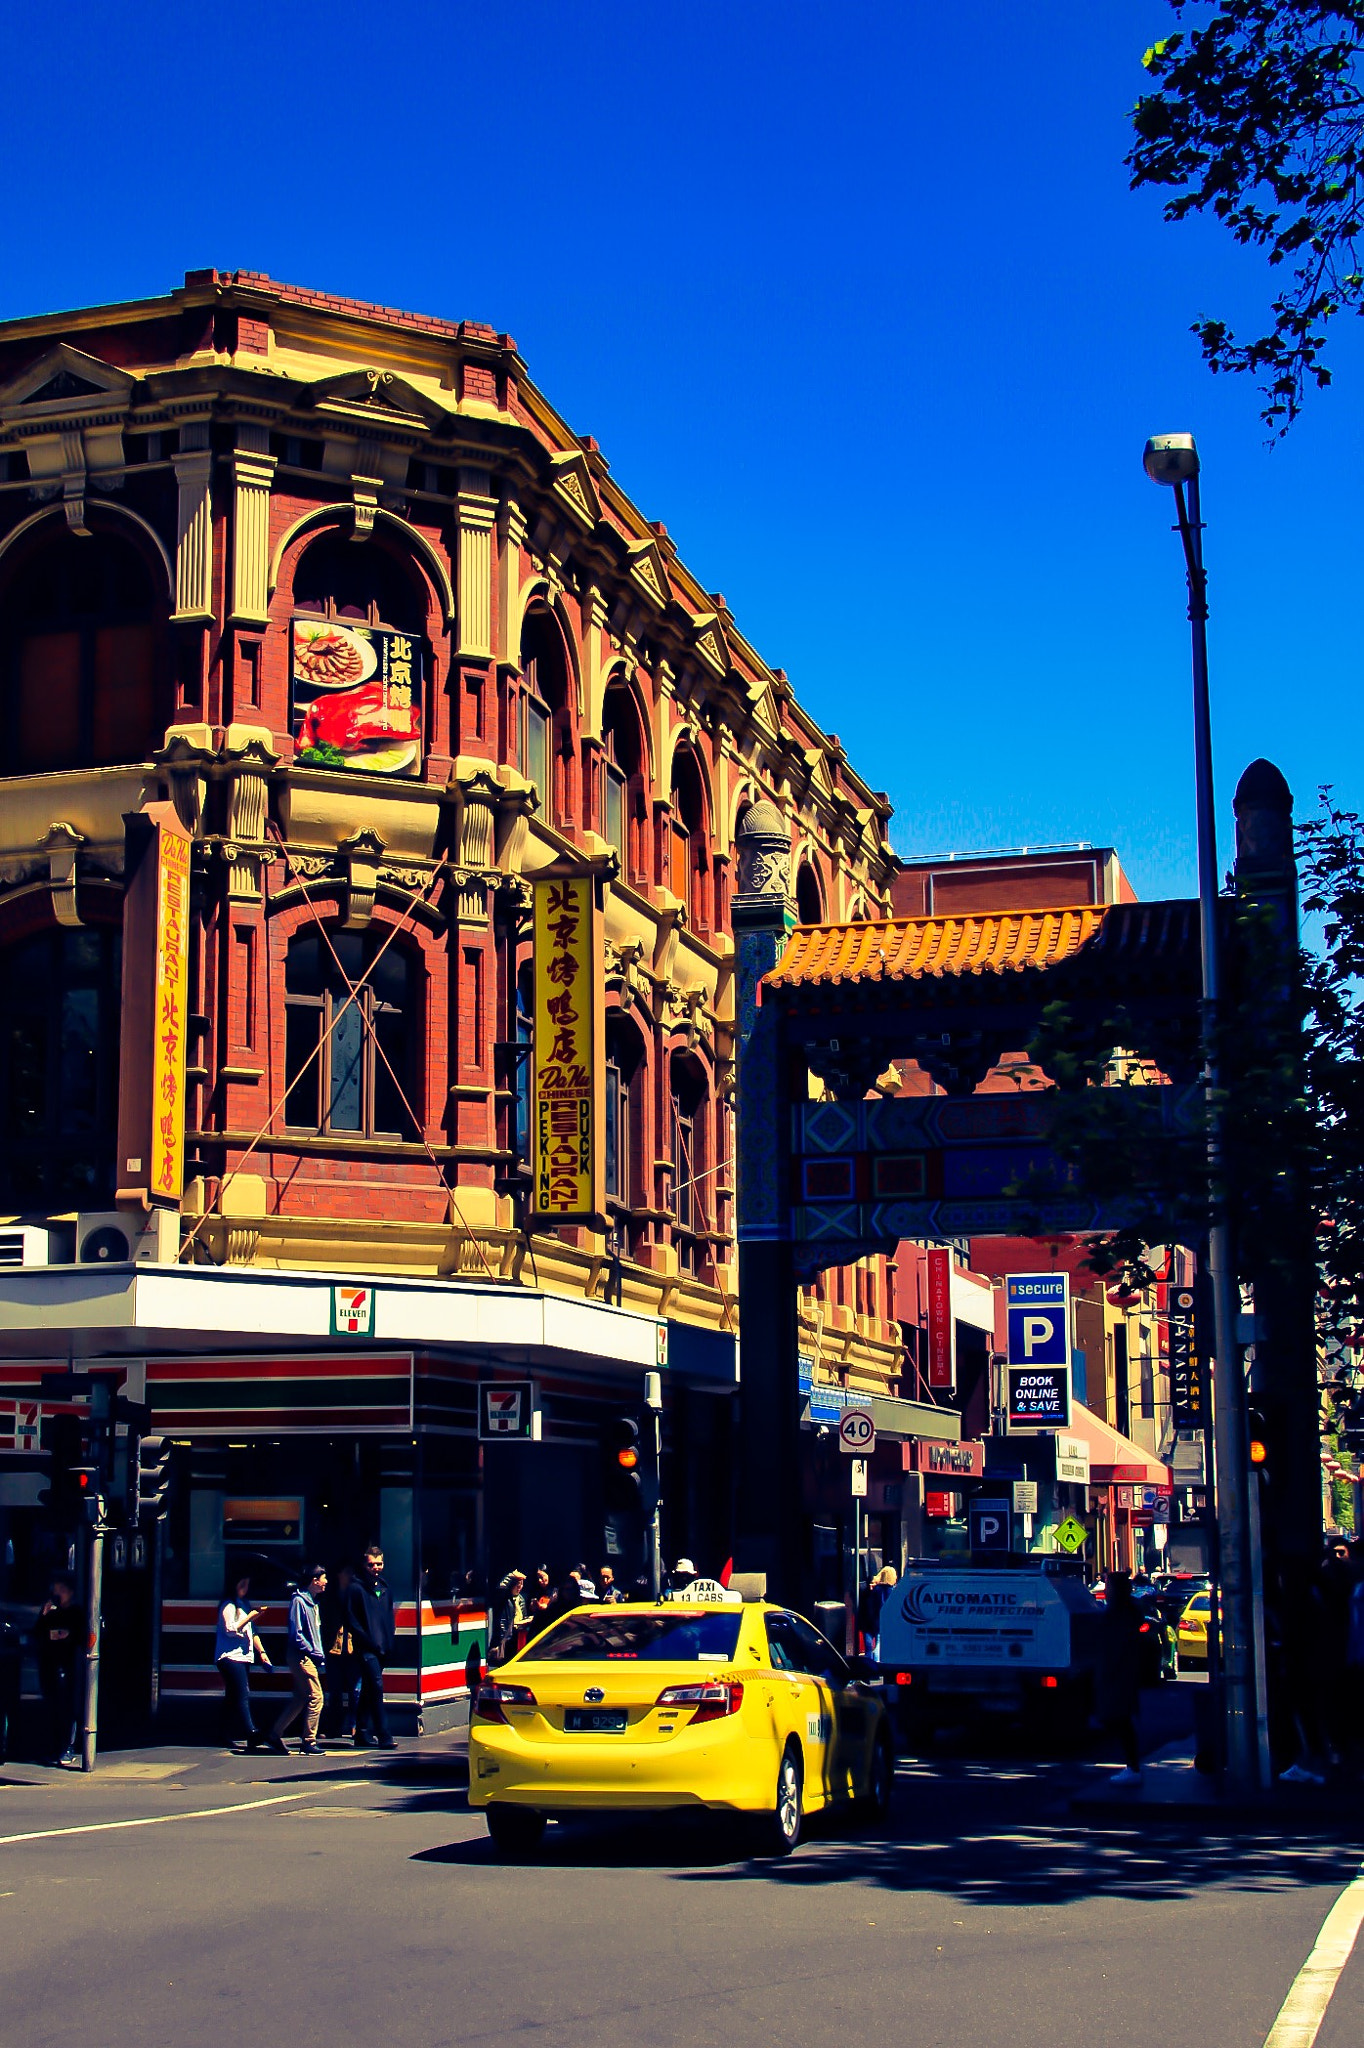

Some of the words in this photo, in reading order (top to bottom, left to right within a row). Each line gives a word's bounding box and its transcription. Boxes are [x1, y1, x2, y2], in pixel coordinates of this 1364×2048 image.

[165, 870, 181, 989] RESTAURANT
[538, 1088, 591, 1100] CHINESE
[579, 1099, 590, 1175] DUCK
[539, 1101, 550, 1210] PEKING
[550, 1100, 578, 1211] RESTAURANT
[934, 1257, 944, 1323] CHINATOWN
[1018, 1283, 1063, 1295] secure
[1023, 1316, 1054, 1357] P
[935, 1332, 944, 1376] CINEMA
[1020, 1376, 1054, 1386] BOOK
[1015, 1388, 1059, 1399] ONLINE
[1016, 1401, 1027, 1412] &
[1029, 1401, 1060, 1411] SAVE
[844, 1421, 870, 1438] 40
[980, 1516, 1000, 1542] P
[694, 1582, 715, 1592] TAXI
[681, 1593, 691, 1602] 13
[697, 1593, 723, 1602] CABS
[922, 1593, 1017, 1605] AUTOMATIC
[937, 1606, 963, 1615] FIRE
[968, 1606, 1046, 1616] PROTECTION
